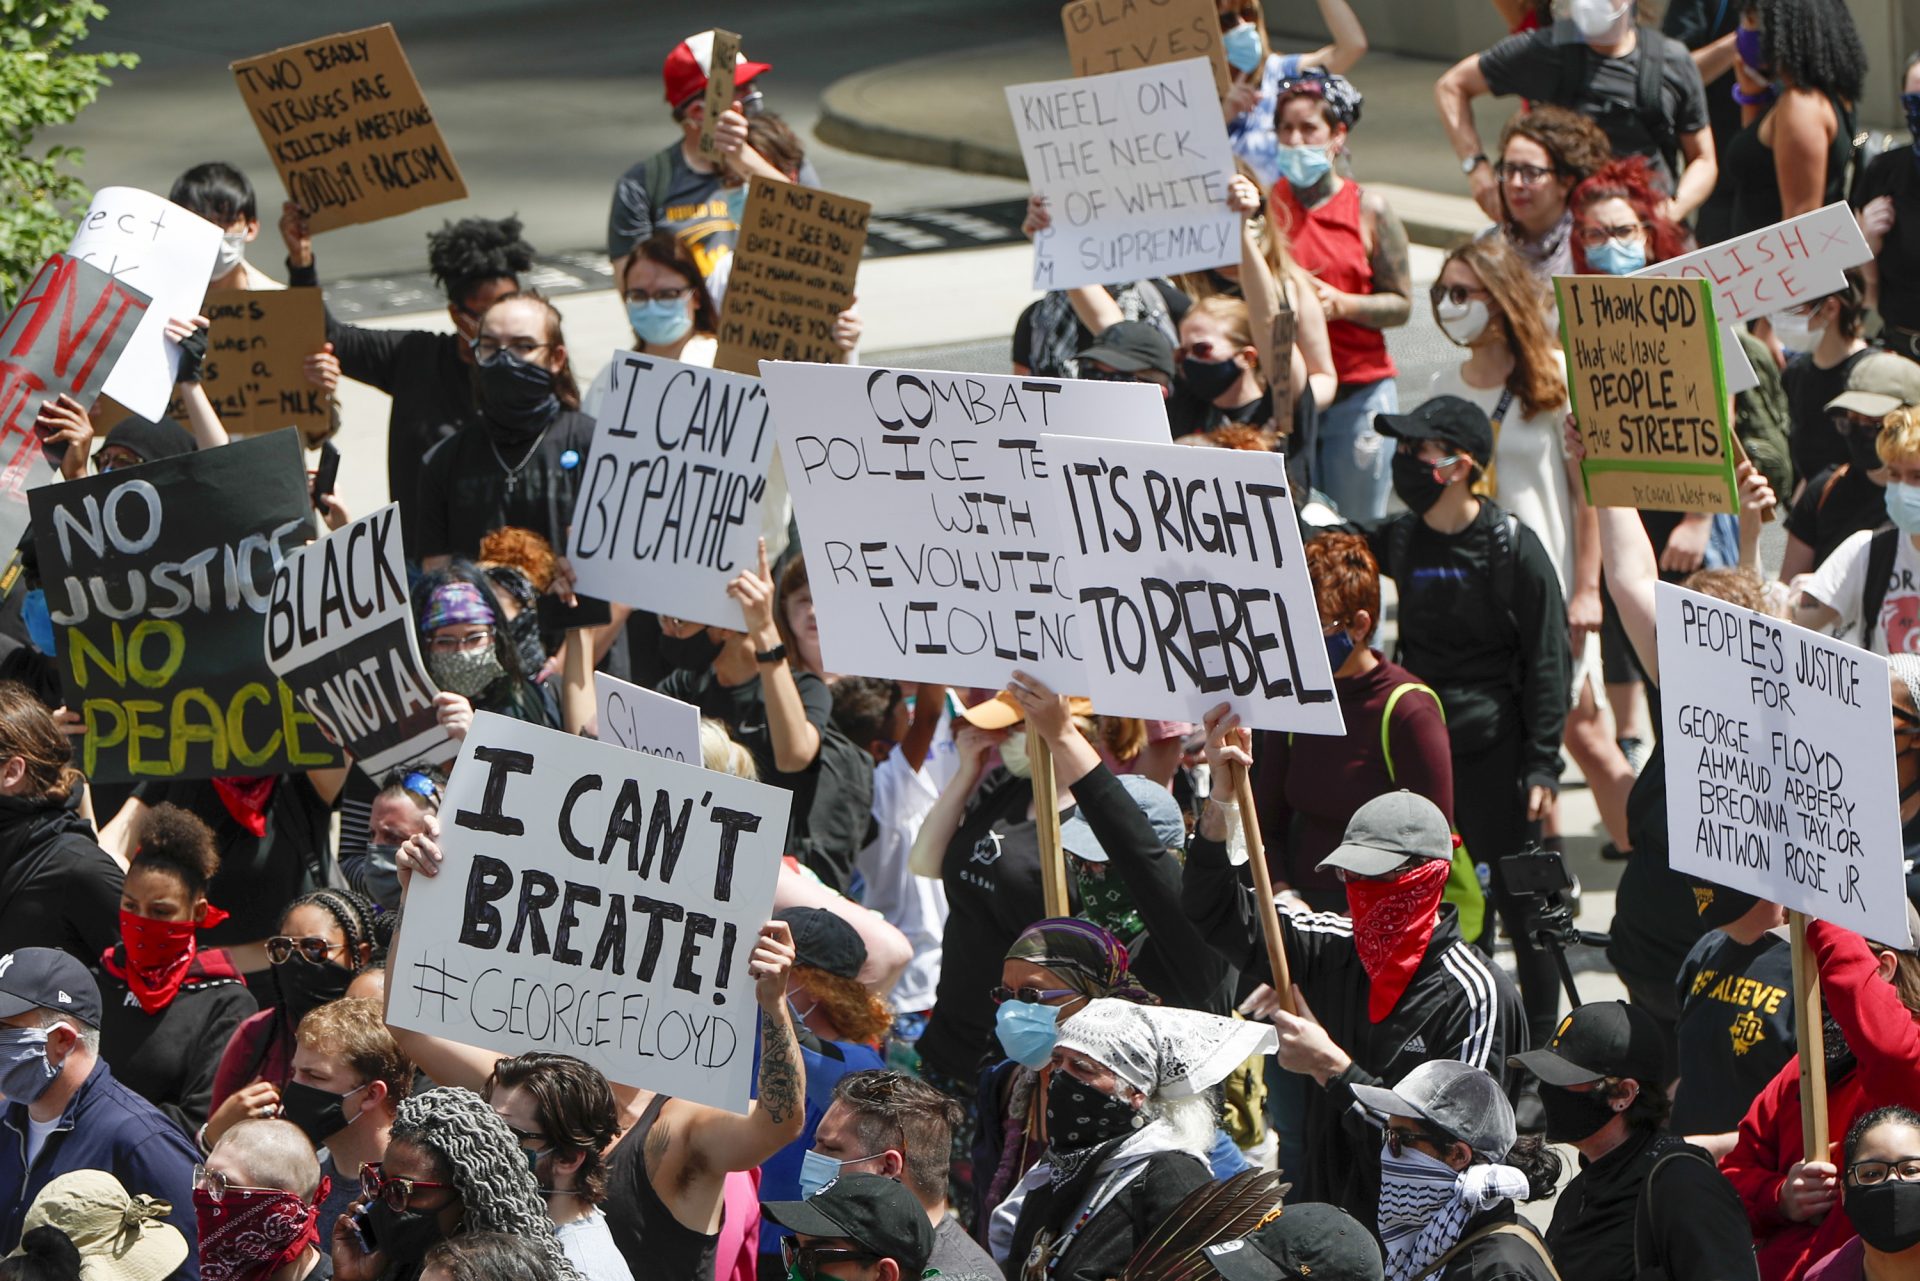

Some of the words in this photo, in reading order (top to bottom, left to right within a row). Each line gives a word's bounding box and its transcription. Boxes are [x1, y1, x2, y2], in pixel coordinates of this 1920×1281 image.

[236, 58, 303, 93] TWO
[303, 39, 370, 73] DEADLY
[1082, 17, 1213, 76] LIVES
[257, 88, 350, 136] VIRUSES
[351, 73, 393, 105] ARE
[1020, 90, 1118, 132] KNEEL
[1138, 79, 1188, 116] ON
[274, 125, 352, 165] KILLING
[367, 143, 456, 192] RACISM
[1033, 139, 1101, 184] THE
[1109, 131, 1207, 167] NECK
[755, 182, 776, 203] I'M
[784, 190, 815, 212] NOT
[817, 199, 868, 231] BLACK
[1064, 189, 1107, 228] OF
[1114, 170, 1227, 215] WHITE
[746, 233, 772, 253] BUT
[758, 208, 785, 230] BUT
[798, 222, 824, 245] SEE
[1078, 222, 1232, 272] SUPREMACY
[207, 300, 265, 321] omes
[767, 308, 803, 335] LOVE
[1570, 284, 1585, 327] I
[1590, 283, 1648, 328] thank
[1649, 284, 1697, 333] GOD
[213, 334, 268, 353] when
[721, 320, 745, 345] I'M
[749, 329, 781, 352] NOT
[1575, 336, 1606, 371] that
[1608, 338, 1627, 367] we
[1628, 330, 1671, 367] have
[250, 361, 273, 379] a
[1588, 367, 1678, 411] PEOPLE
[654, 368, 771, 464] CAN'T
[866, 368, 1063, 432] COMBAT
[795, 434, 986, 485] POLICE
[998, 438, 1050, 481] TE
[1587, 416, 1612, 455] the
[1619, 413, 1727, 460] STREETS.
[931, 491, 1036, 539] WITH
[1062, 456, 1142, 555] IT'S
[1142, 468, 1287, 569] RIGHT
[1676, 480, 1707, 507] West
[53, 479, 163, 568] NO
[268, 508, 407, 663] BLACK
[67, 619, 186, 690] NO
[878, 600, 1084, 662] VIOLENC
[1078, 586, 1147, 676] TO
[1140, 576, 1334, 705] REBEL
[1681, 599, 1784, 675] PEOPLE'S
[1795, 639, 1862, 709] JUSTICE
[321, 655, 398, 743] NOT
[389, 647, 432, 718] A
[1750, 676, 1797, 717] FOR
[82, 678, 334, 780] PEACE
[1678, 704, 1750, 755] GEORGE
[1771, 731, 1844, 792] FLOYD
[1697, 745, 1772, 795] AHMAUD
[1783, 776, 1856, 829] ARBERY
[454, 744, 535, 837] I
[558, 773, 763, 902] CAN'T
[1698, 779, 1790, 838] BREONNA
[1796, 810, 1865, 859] TAYLOR
[1695, 816, 1771, 872] ANTWON
[1784, 841, 1828, 894] ROSE
[1838, 864, 1867, 913] JR
[458, 853, 738, 1006] BREATE!
[412, 949, 738, 1069] #GEORGEFLOYD
[1733, 1014, 1760, 1043] 50
